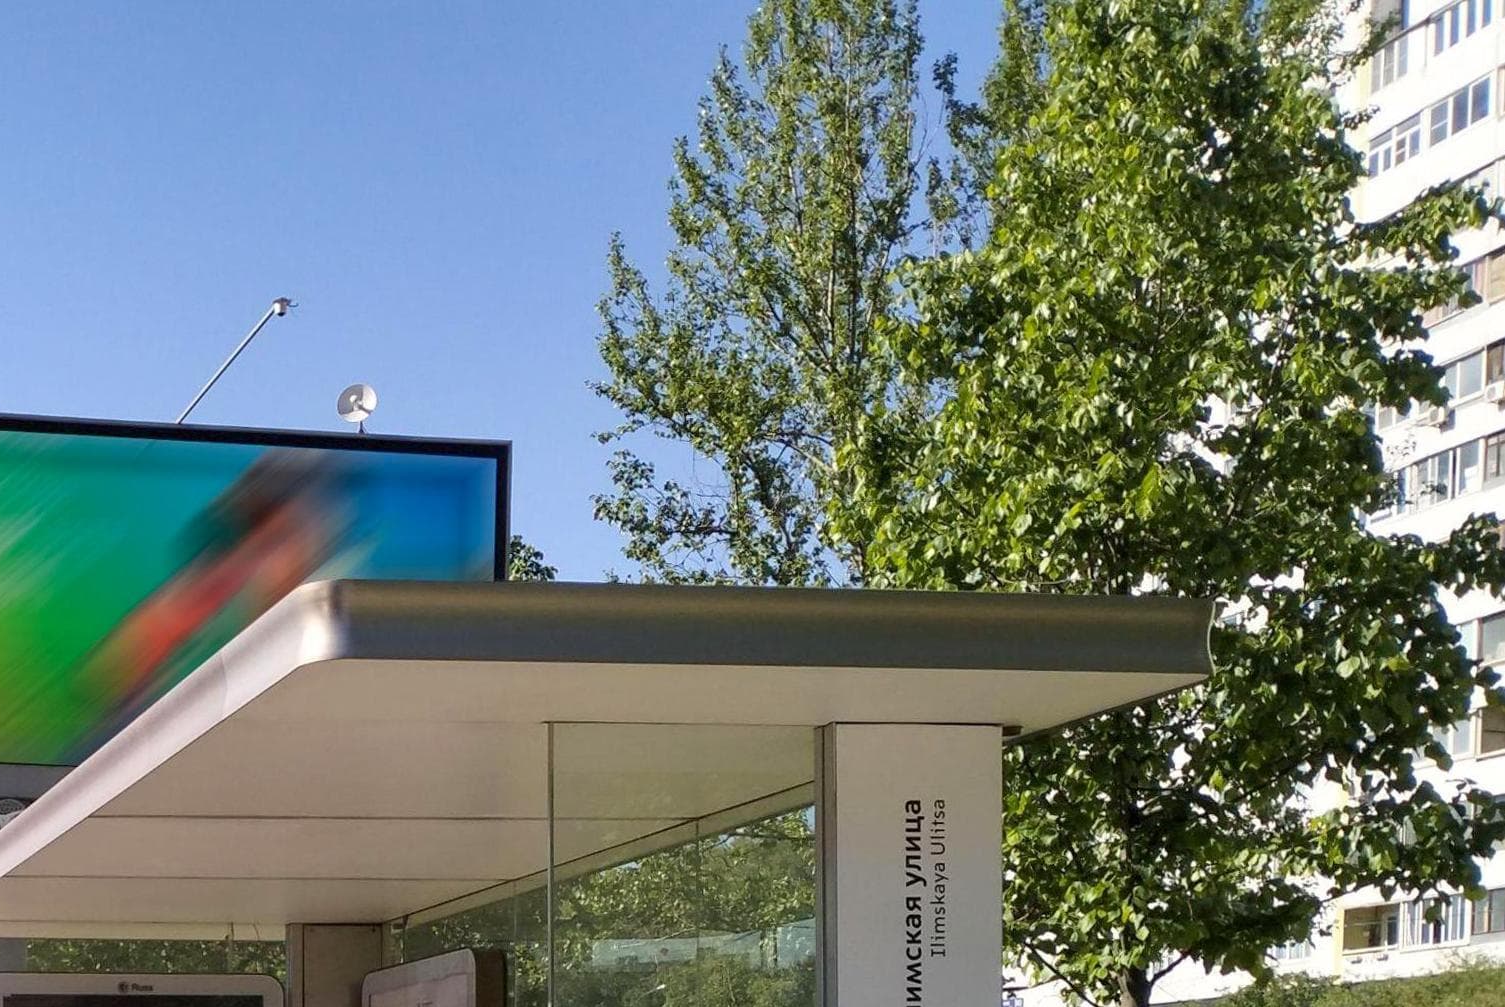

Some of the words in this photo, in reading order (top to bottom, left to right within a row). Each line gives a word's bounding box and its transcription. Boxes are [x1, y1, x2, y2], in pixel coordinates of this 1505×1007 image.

[904, 799, 927, 888] улица
[929, 799, 946, 856] Ulitsa
[929, 861, 950, 957] Ilimskaya
